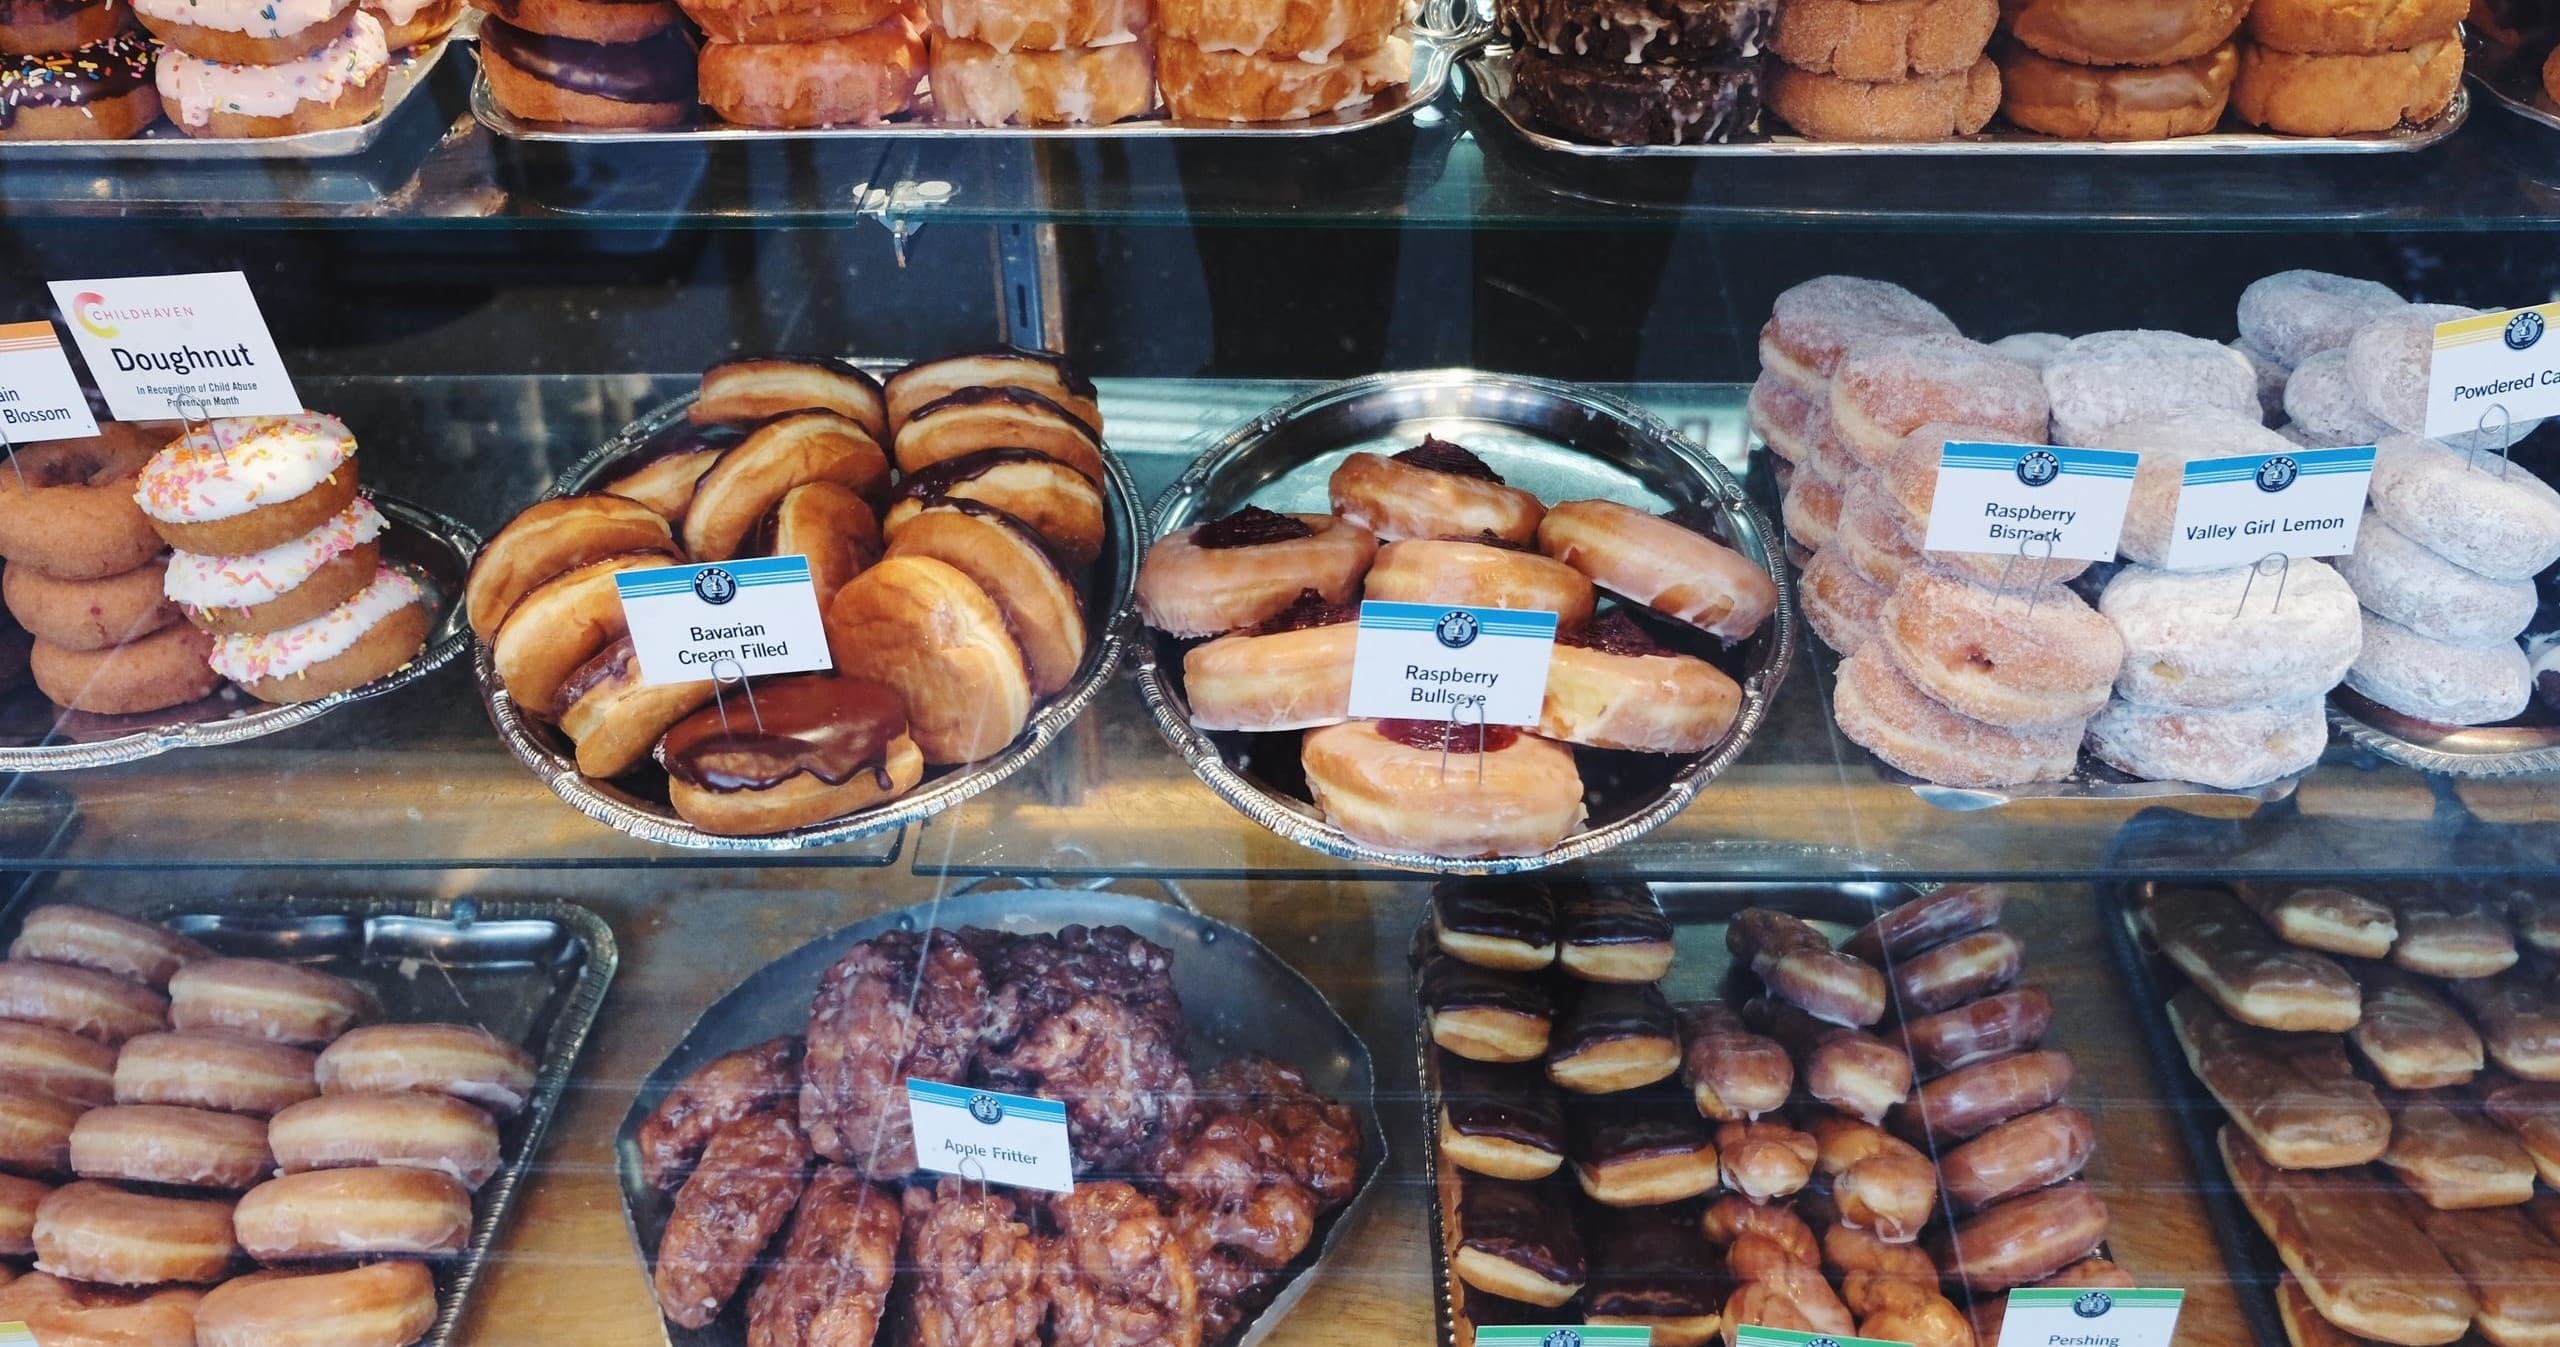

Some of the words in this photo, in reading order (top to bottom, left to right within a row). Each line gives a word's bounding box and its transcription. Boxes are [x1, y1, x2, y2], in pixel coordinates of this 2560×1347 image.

[92, 306, 194, 321] CHILDHAVEN
[111, 343, 254, 375] Doughnut
[136, 385, 145, 395] In
[147, 384, 196, 396] Recognition
[208, 382, 230, 393] Child
[232, 381, 258, 391] Abuse
[2454, 372, 2535, 401] Powdered
[213, 395, 240, 405] Month
[3, 407, 72, 424] Blossom
[2043, 452, 2058, 466] POT
[2280, 457, 2296, 470] POT
[1985, 502, 2077, 525] Raspberry
[2186, 523, 2237, 541] Valley
[2243, 519, 2275, 536] Girl
[2283, 516, 2345, 532] Lemon
[695, 569, 709, 584] TOP
[713, 569, 732, 582] POT
[1439, 612, 1458, 625] TOP
[1460, 612, 1477, 627] POT
[690, 622, 766, 642] Bavarian
[678, 648, 736, 665] Cream
[741, 640, 789, 660] Filled
[1405, 664, 1499, 688] Raspberry
[944, 1138, 986, 1157] Apple
[992, 1146, 1039, 1165] Fritter
[2048, 1334, 2121, 1347] Pershing
